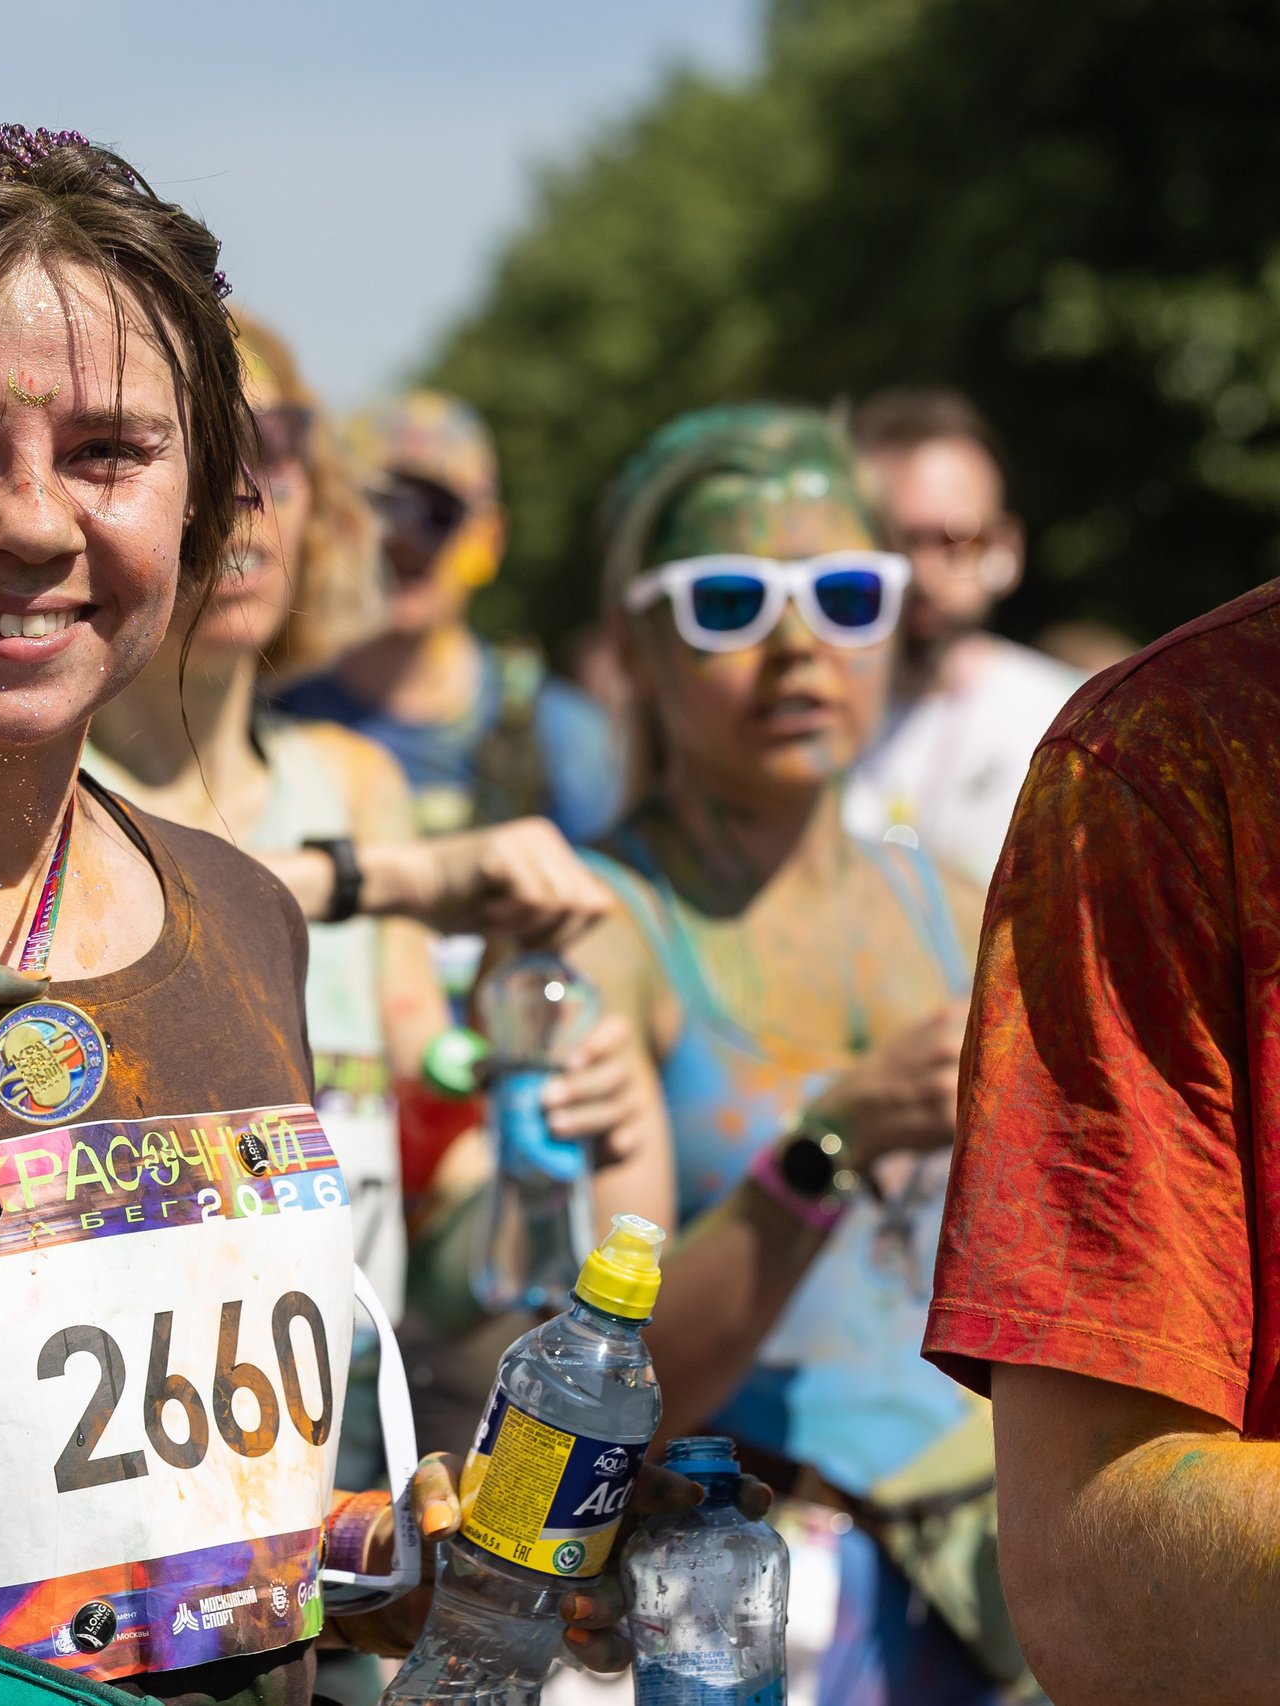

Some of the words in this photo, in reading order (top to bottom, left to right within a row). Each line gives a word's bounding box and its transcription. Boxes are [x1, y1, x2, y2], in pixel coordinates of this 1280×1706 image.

[40, 891, 55, 928] ЗАБЕГ
[197, 1174, 342, 1223] 2026
[37, 1290, 333, 1493] 2660
[593, 1455, 629, 1473] AQUA
[199, 1585, 258, 1614] МОСКОВСКИЙ
[85, 1604, 107, 1632] LONG
[92, 1609, 112, 1636] DISTANCE
[117, 1612, 138, 1620] мент
[202, 1609, 234, 1630] СПОРТ
[116, 1631, 150, 1641] Москвы
